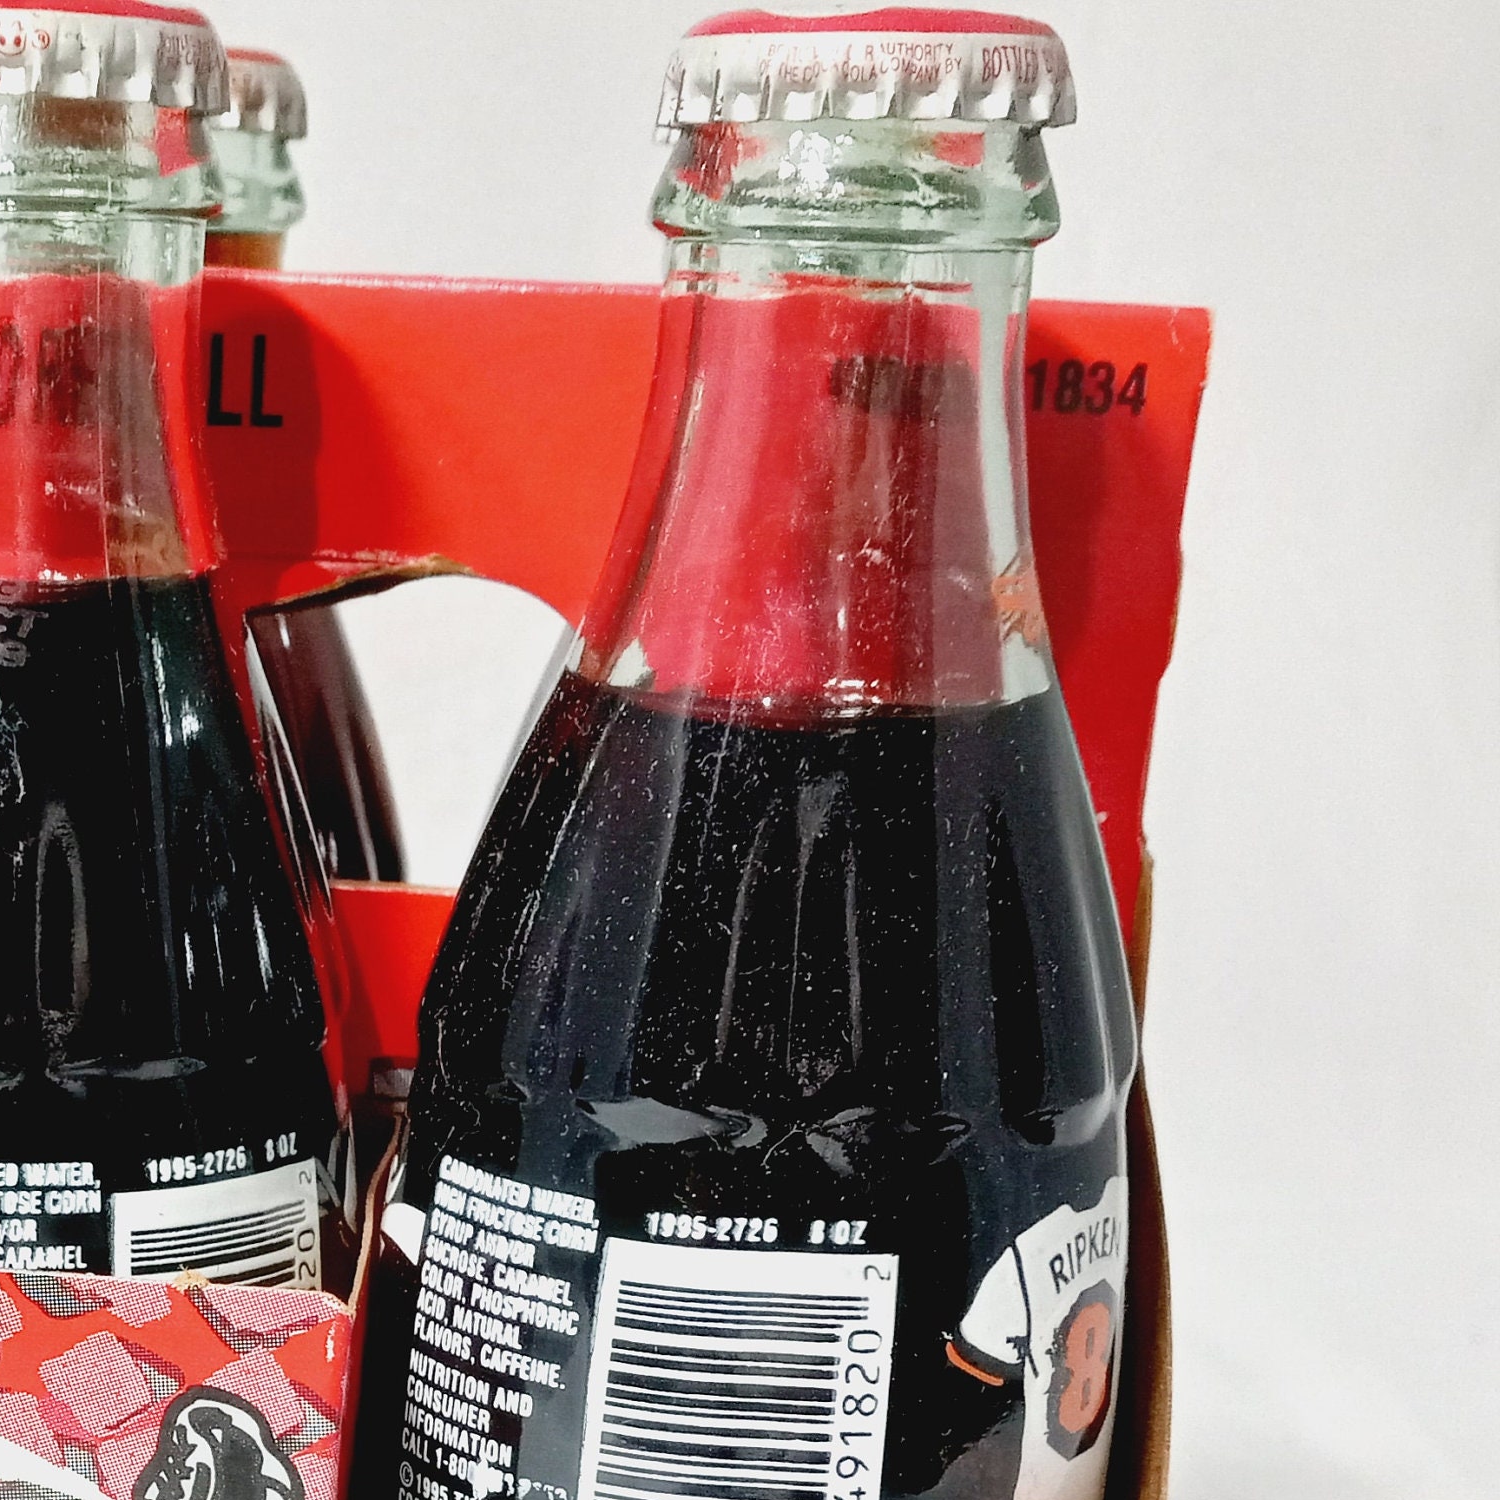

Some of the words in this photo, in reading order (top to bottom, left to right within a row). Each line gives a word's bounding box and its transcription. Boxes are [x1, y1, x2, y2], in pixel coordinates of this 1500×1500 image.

[945, 57, 962, 75] BY
[145, 1146, 246, 1183] 1995-2726
[276, 1132, 297, 1158] OZ
[45, 1190, 101, 1214] CORN
[430, 1207, 474, 1246] SYRUP
[646, 1211, 779, 1244] 1995-2726
[830, 1220, 868, 1245] OZ
[493, 1262, 574, 1306] CARAMEL
[453, 1304, 522, 1349] NATURAL
[471, 1282, 580, 1336] PHOSPHORIC
[409, 1348, 490, 1405] NUTRITION
[493, 1386, 533, 1418] AND
[480, 1345, 566, 1389] CAFFEINE.
[1053, 1292, 1113, 1444] 8
[407, 1375, 491, 1433] CONSUMER
[402, 1427, 431, 1464] CALL
[404, 1400, 513, 1467] INFORMATION
